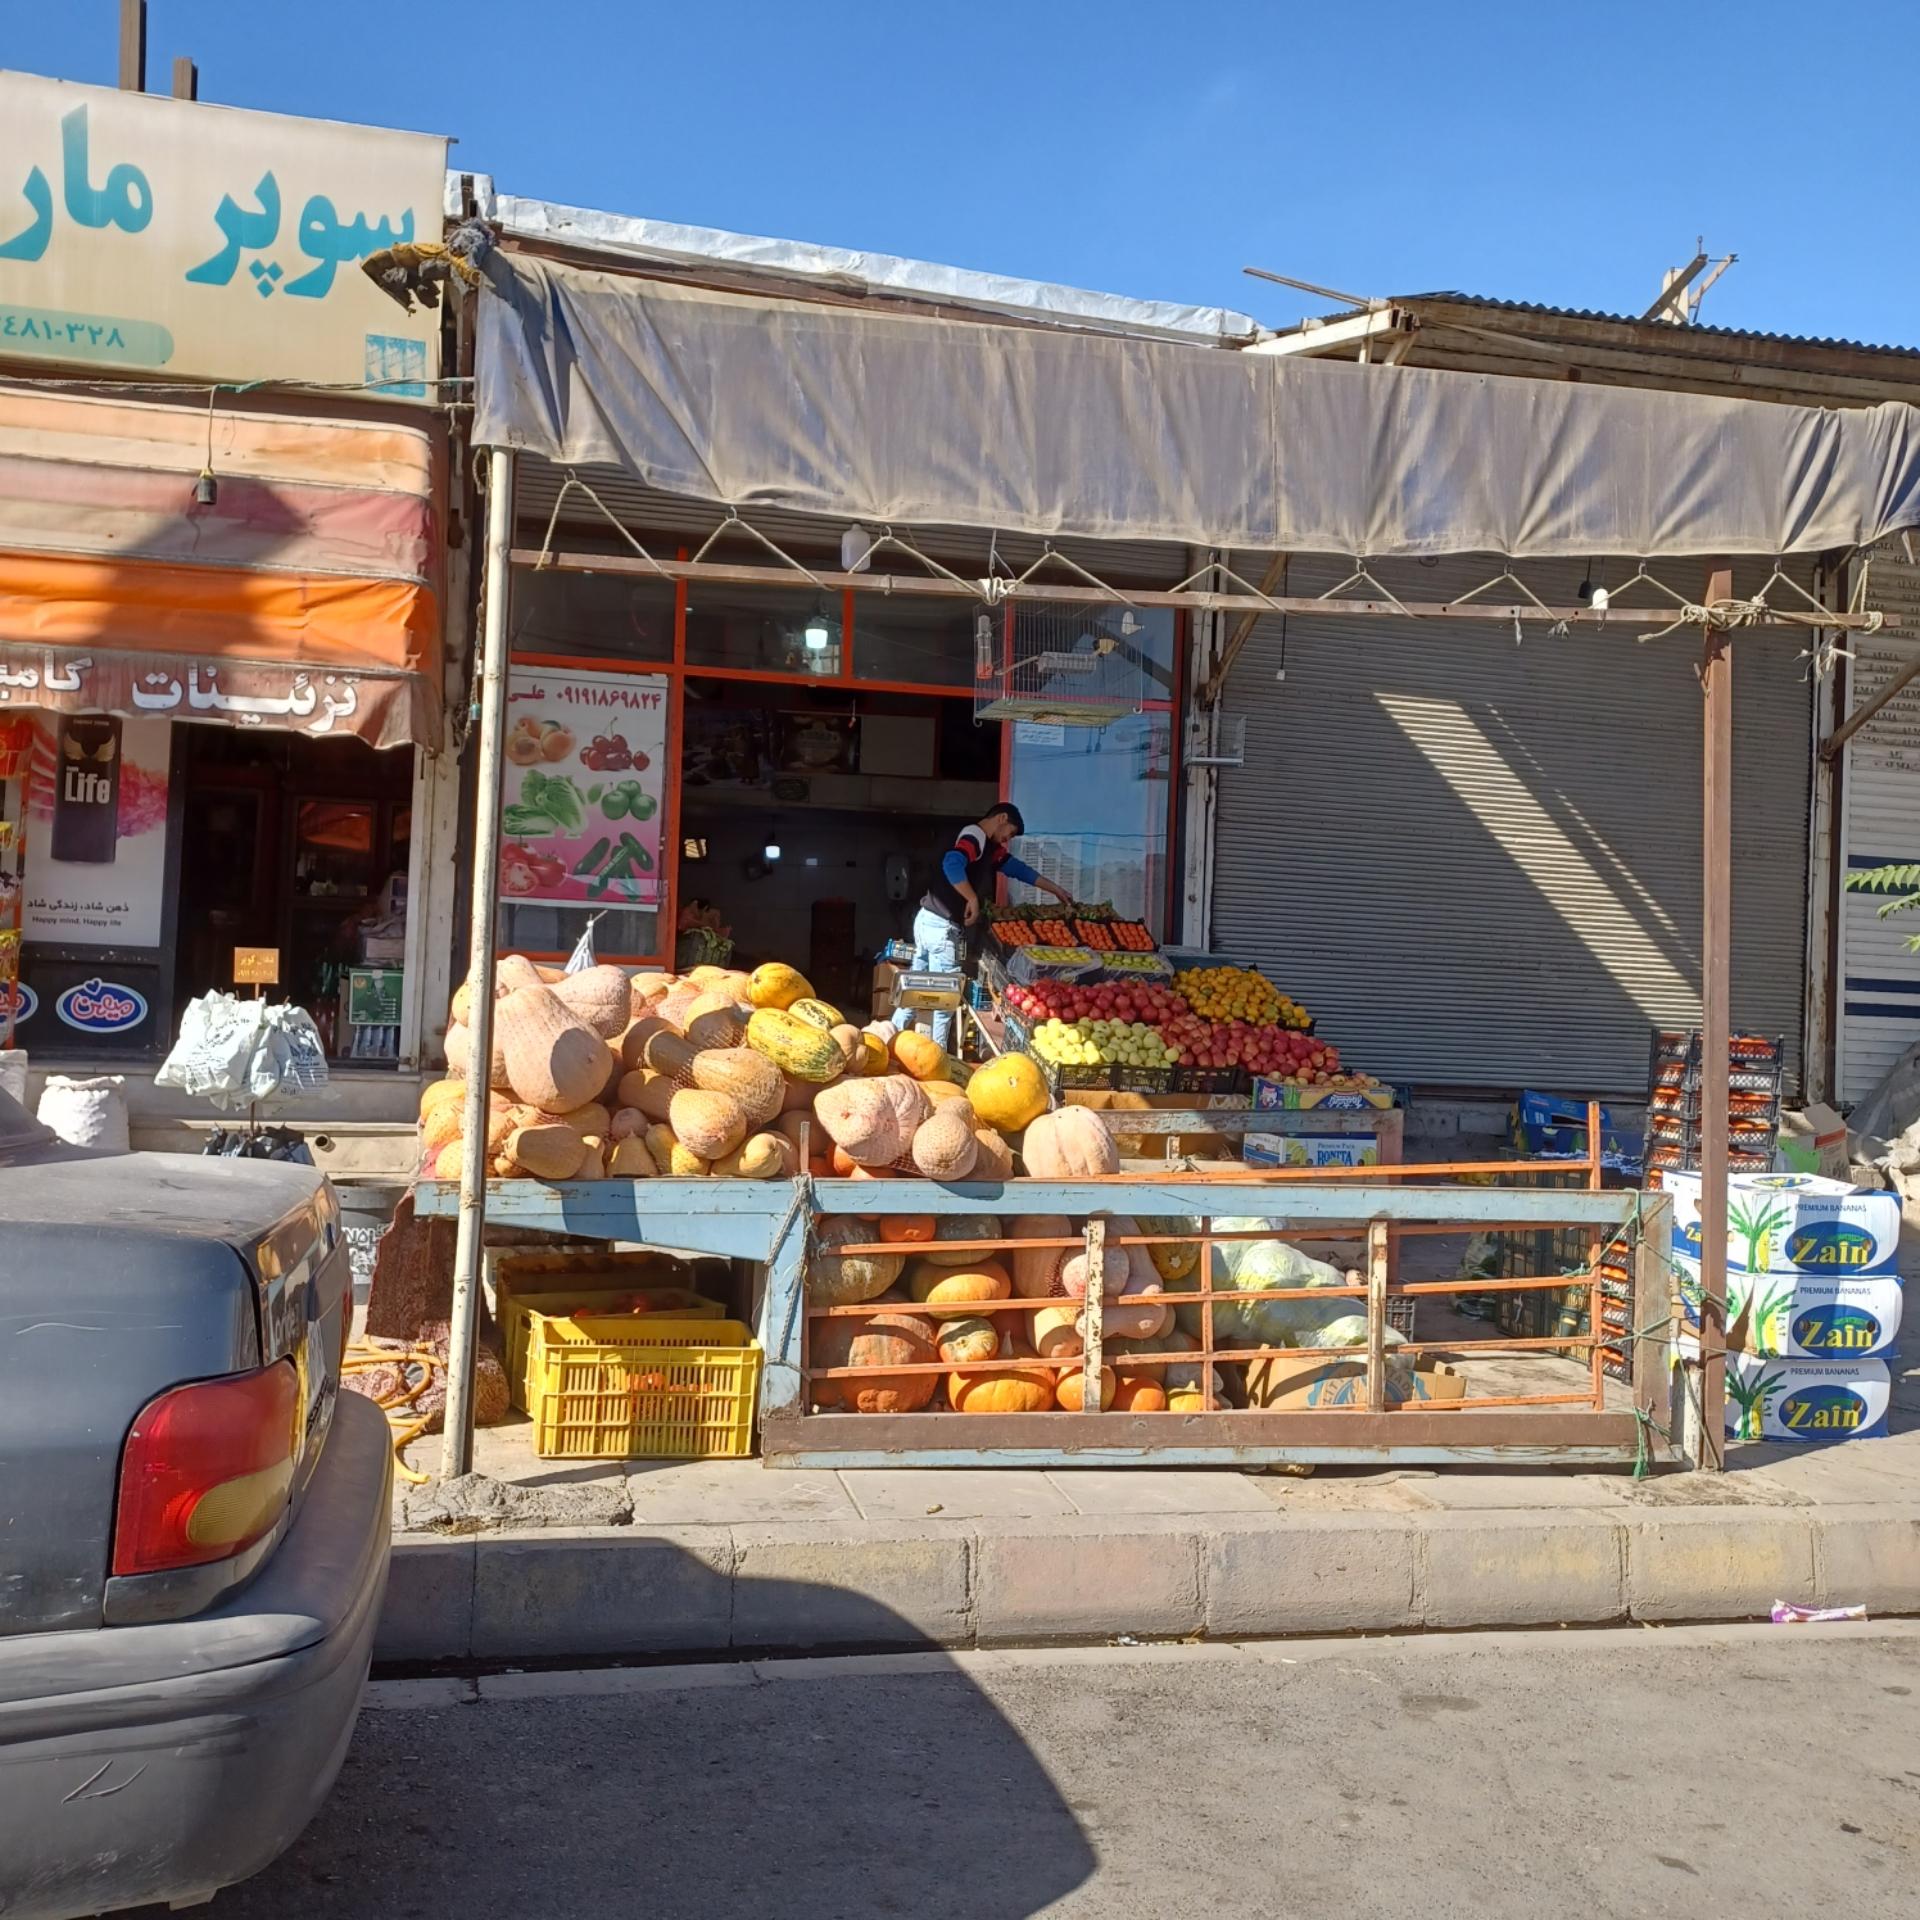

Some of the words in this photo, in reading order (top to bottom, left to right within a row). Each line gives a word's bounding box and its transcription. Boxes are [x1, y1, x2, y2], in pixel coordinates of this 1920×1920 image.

[185, 169, 415, 299] سوپر
[64, 771, 111, 804] Life
[32, 916, 57, 925] Happy
[83, 918, 107, 927] Happy
[1795, 1203, 1829, 1212] PREMIUM
[1829, 1203, 1867, 1213] BANANAS
[1800, 1286, 1834, 1296] PREMIUM
[1835, 1287, 1871, 1296] BANANAS
[1790, 1367, 1825, 1377] PREMIUM
[1825, 1367, 1860, 1377] BANANAS
